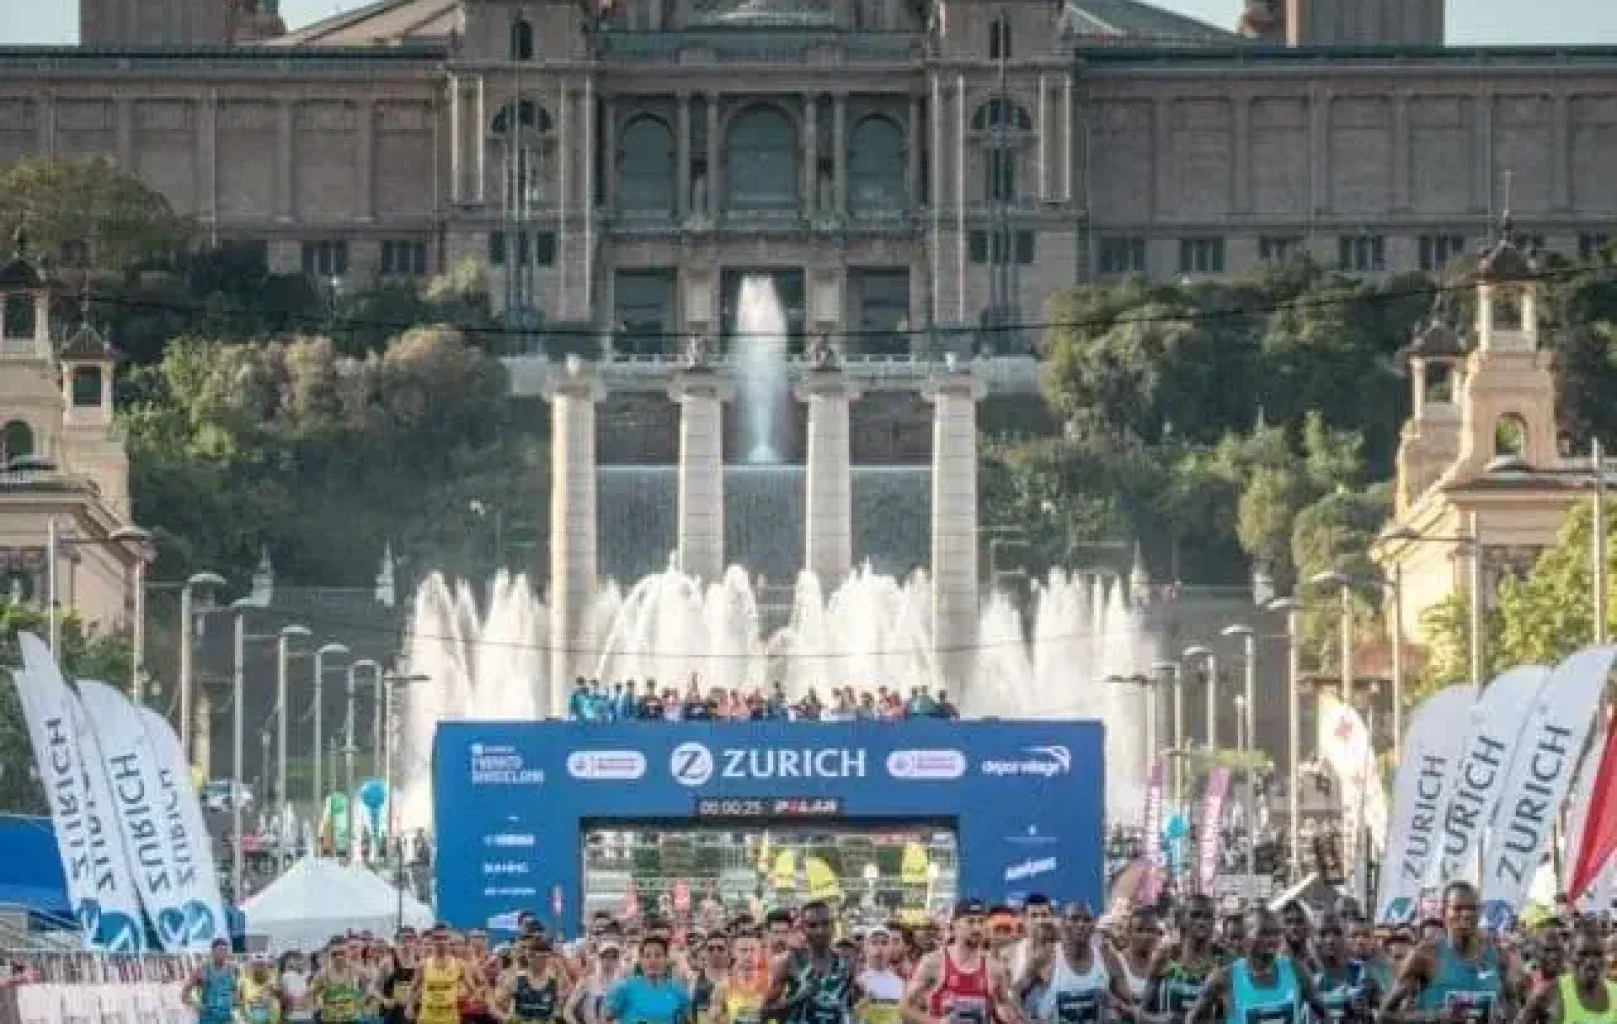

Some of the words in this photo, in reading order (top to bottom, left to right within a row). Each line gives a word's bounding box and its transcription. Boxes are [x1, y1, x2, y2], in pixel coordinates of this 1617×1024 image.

[721, 749, 867, 777] ZURICH
[1402, 755, 1446, 880] ZURICH
[1496, 724, 1573, 883] ZURICH
